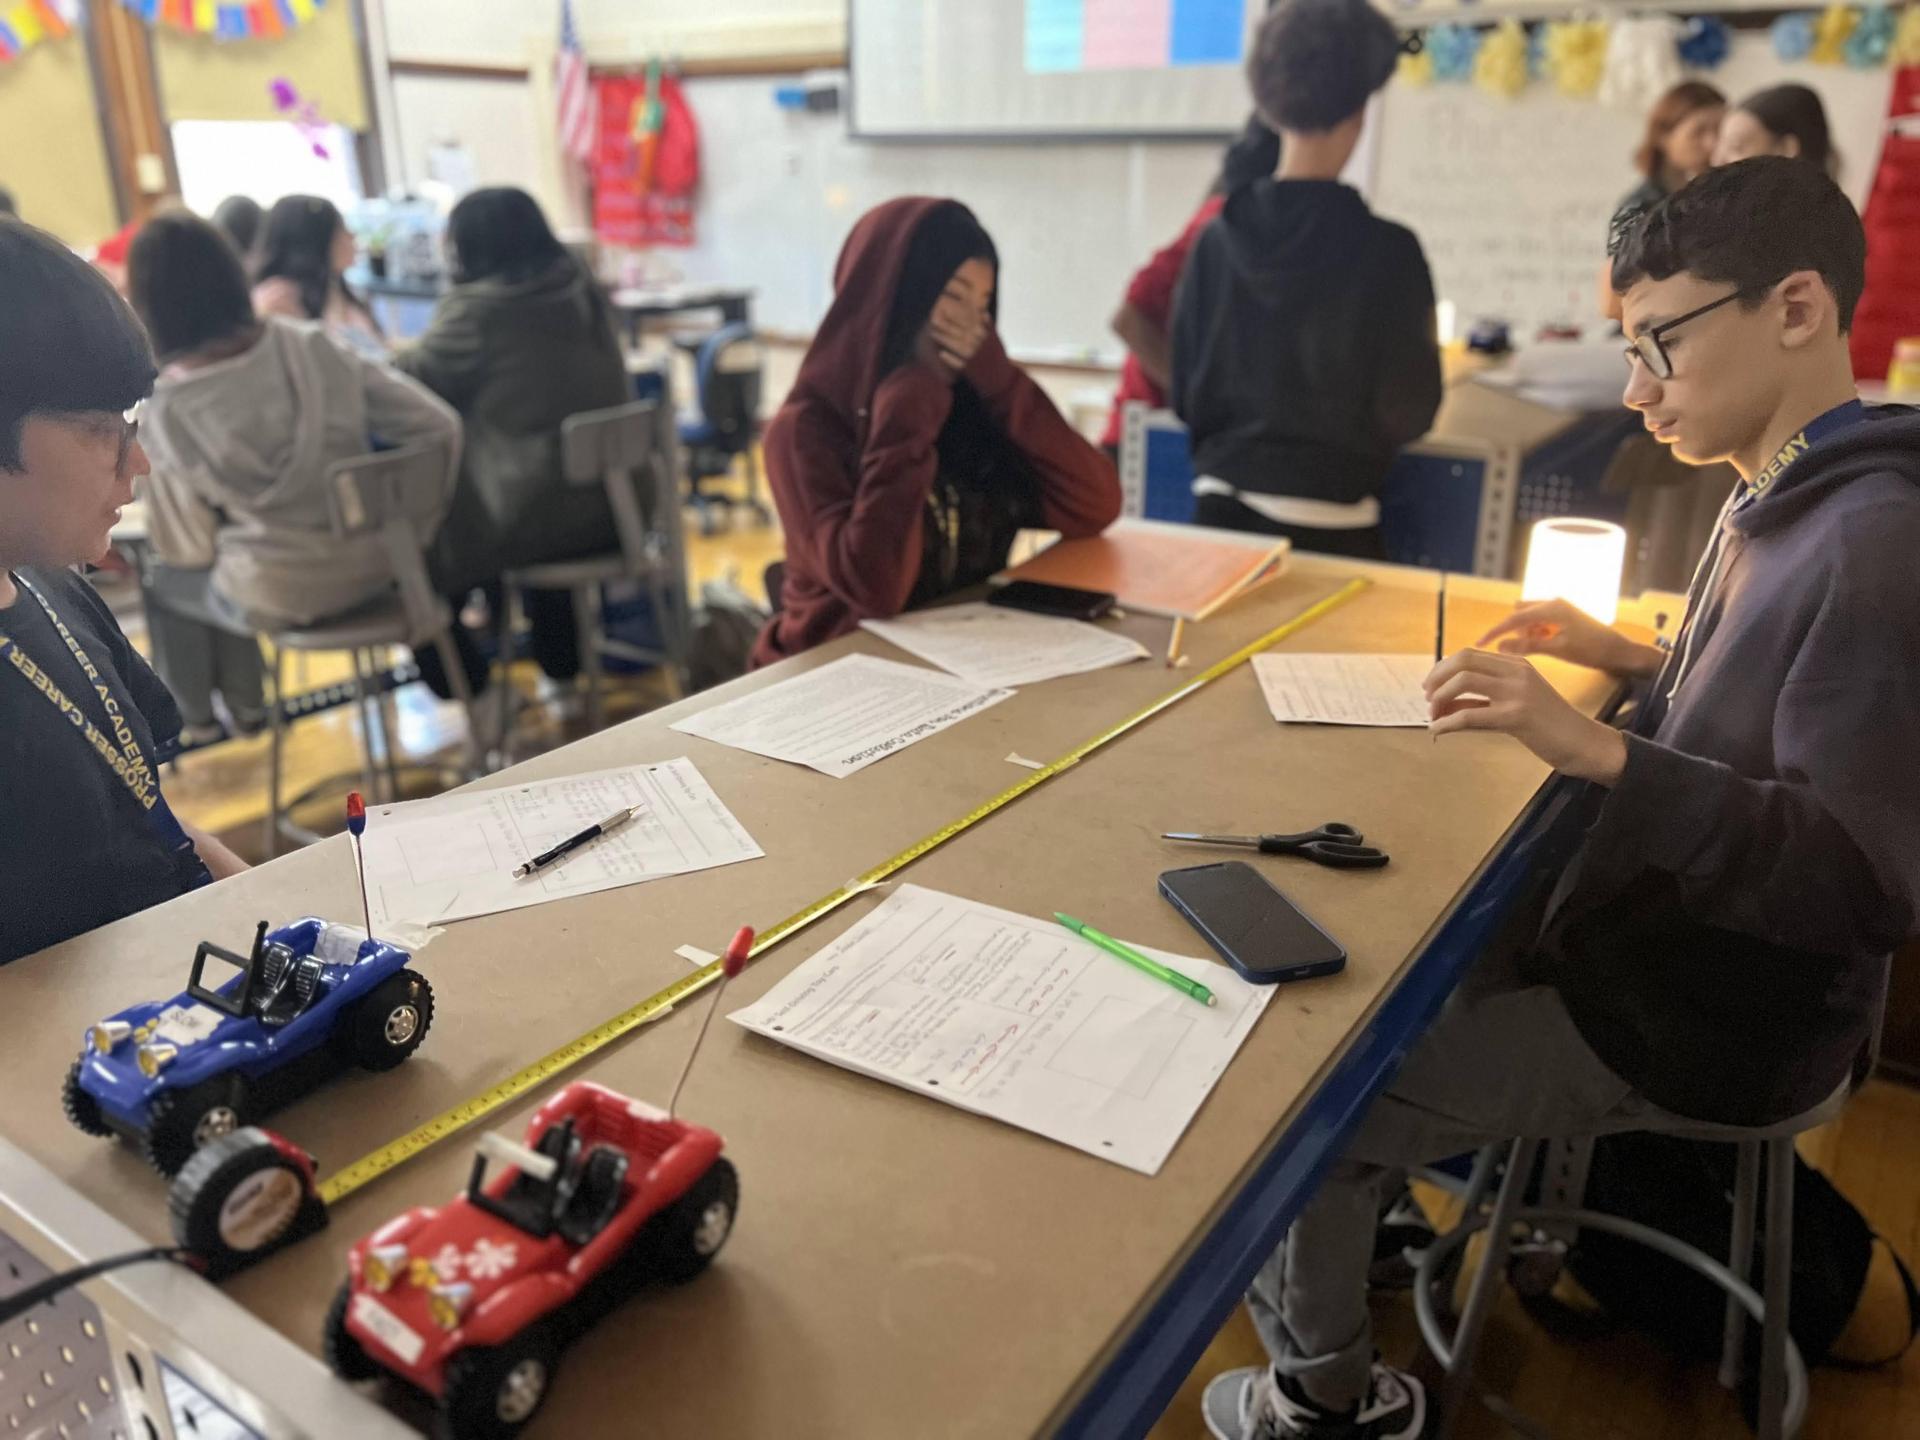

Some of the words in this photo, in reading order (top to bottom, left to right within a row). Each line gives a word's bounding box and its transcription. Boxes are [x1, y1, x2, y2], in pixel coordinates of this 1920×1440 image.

[9, 644, 84, 726] CAREER
[36, 592, 98, 682] CAREER
[95, 684, 156, 787] ACADEMY
[85, 720, 158, 810] PROSSER
